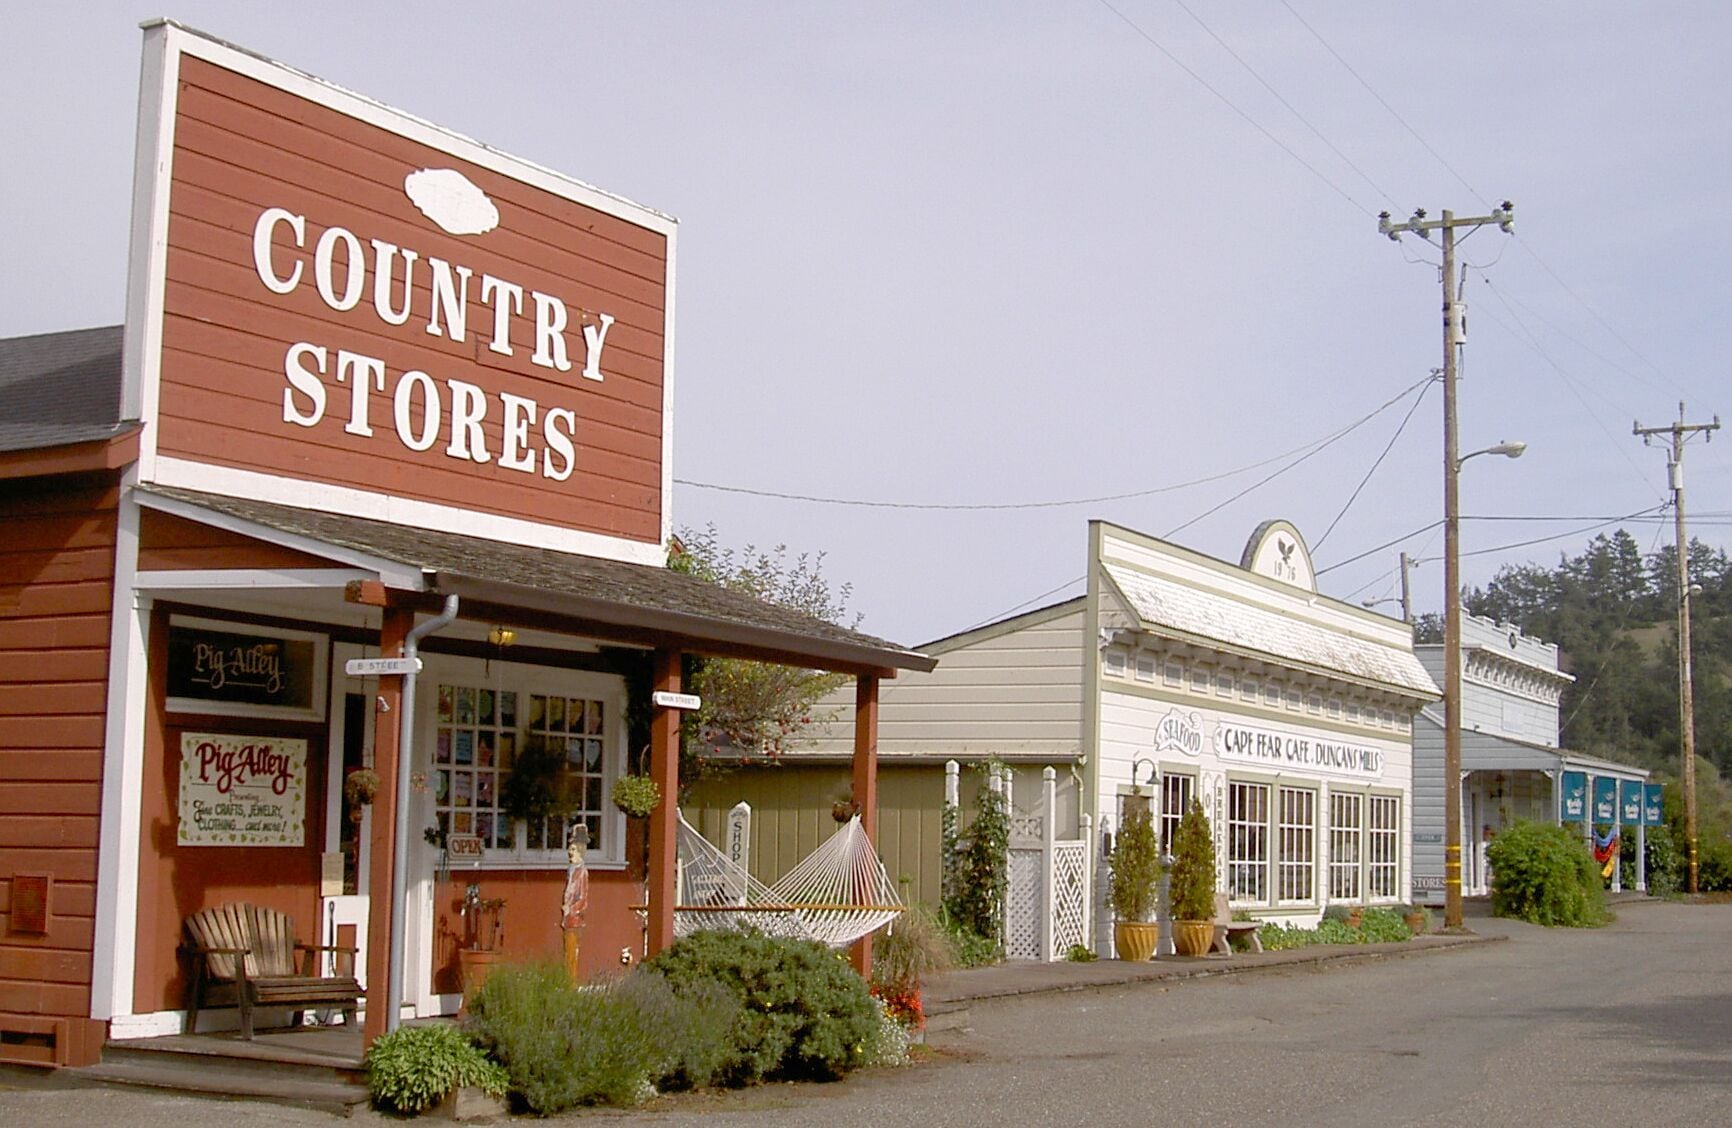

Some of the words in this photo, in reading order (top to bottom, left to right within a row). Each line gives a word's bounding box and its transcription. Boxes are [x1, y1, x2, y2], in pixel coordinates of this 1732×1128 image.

[253, 207, 615, 382] COUNTRY
[282, 342, 576, 482] STORES
[193, 643, 225, 690] Pig
[229, 643, 285, 694] Alley
[1163, 718, 1201, 752] SEAFOOD
[1224, 728, 1253, 756] CAPE
[1256, 733, 1282, 760] FEAR
[1315, 742, 1358, 770] DUNCANS
[1358, 750, 1380, 772] MILLS
[195, 742, 236, 794] Pig
[233, 744, 294, 795] Alley
[214, 803, 247, 818] CRAFTS,
[247, 804, 284, 819] JEWELRY,
[451, 838, 482, 855] OPEN
[732, 821, 743, 863] SHOP
